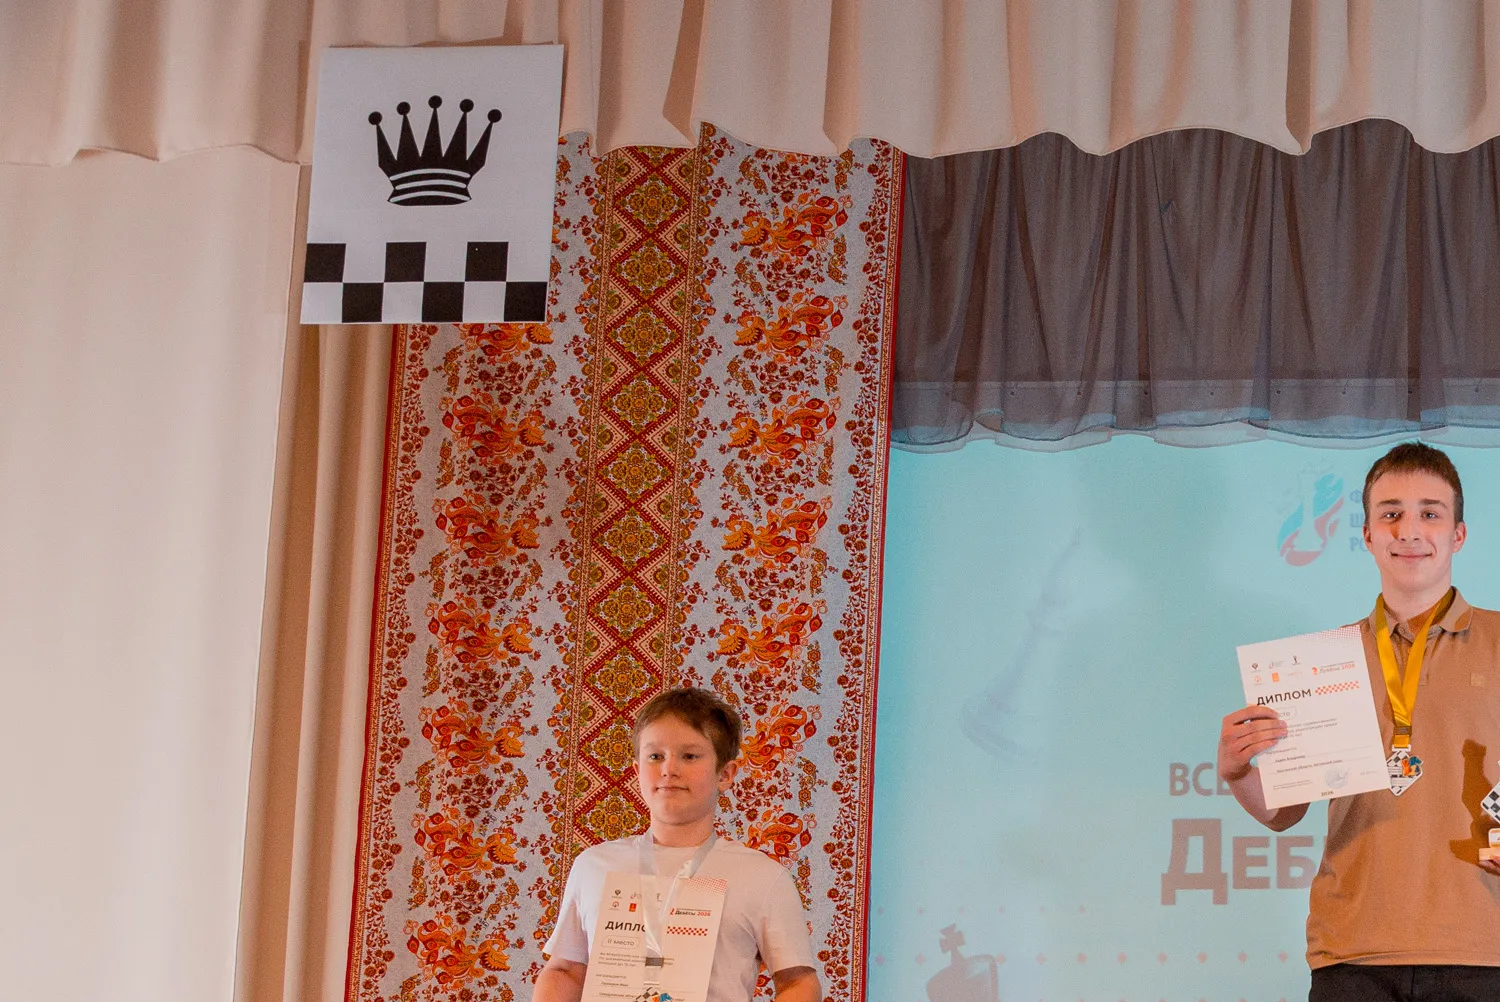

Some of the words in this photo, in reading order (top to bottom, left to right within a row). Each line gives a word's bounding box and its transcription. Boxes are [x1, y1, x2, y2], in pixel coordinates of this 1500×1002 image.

[1256, 688, 1312, 706] ДИПЛОМ
[605, 919, 647, 933] ДИПЛО
[613, 939, 634, 947] место
